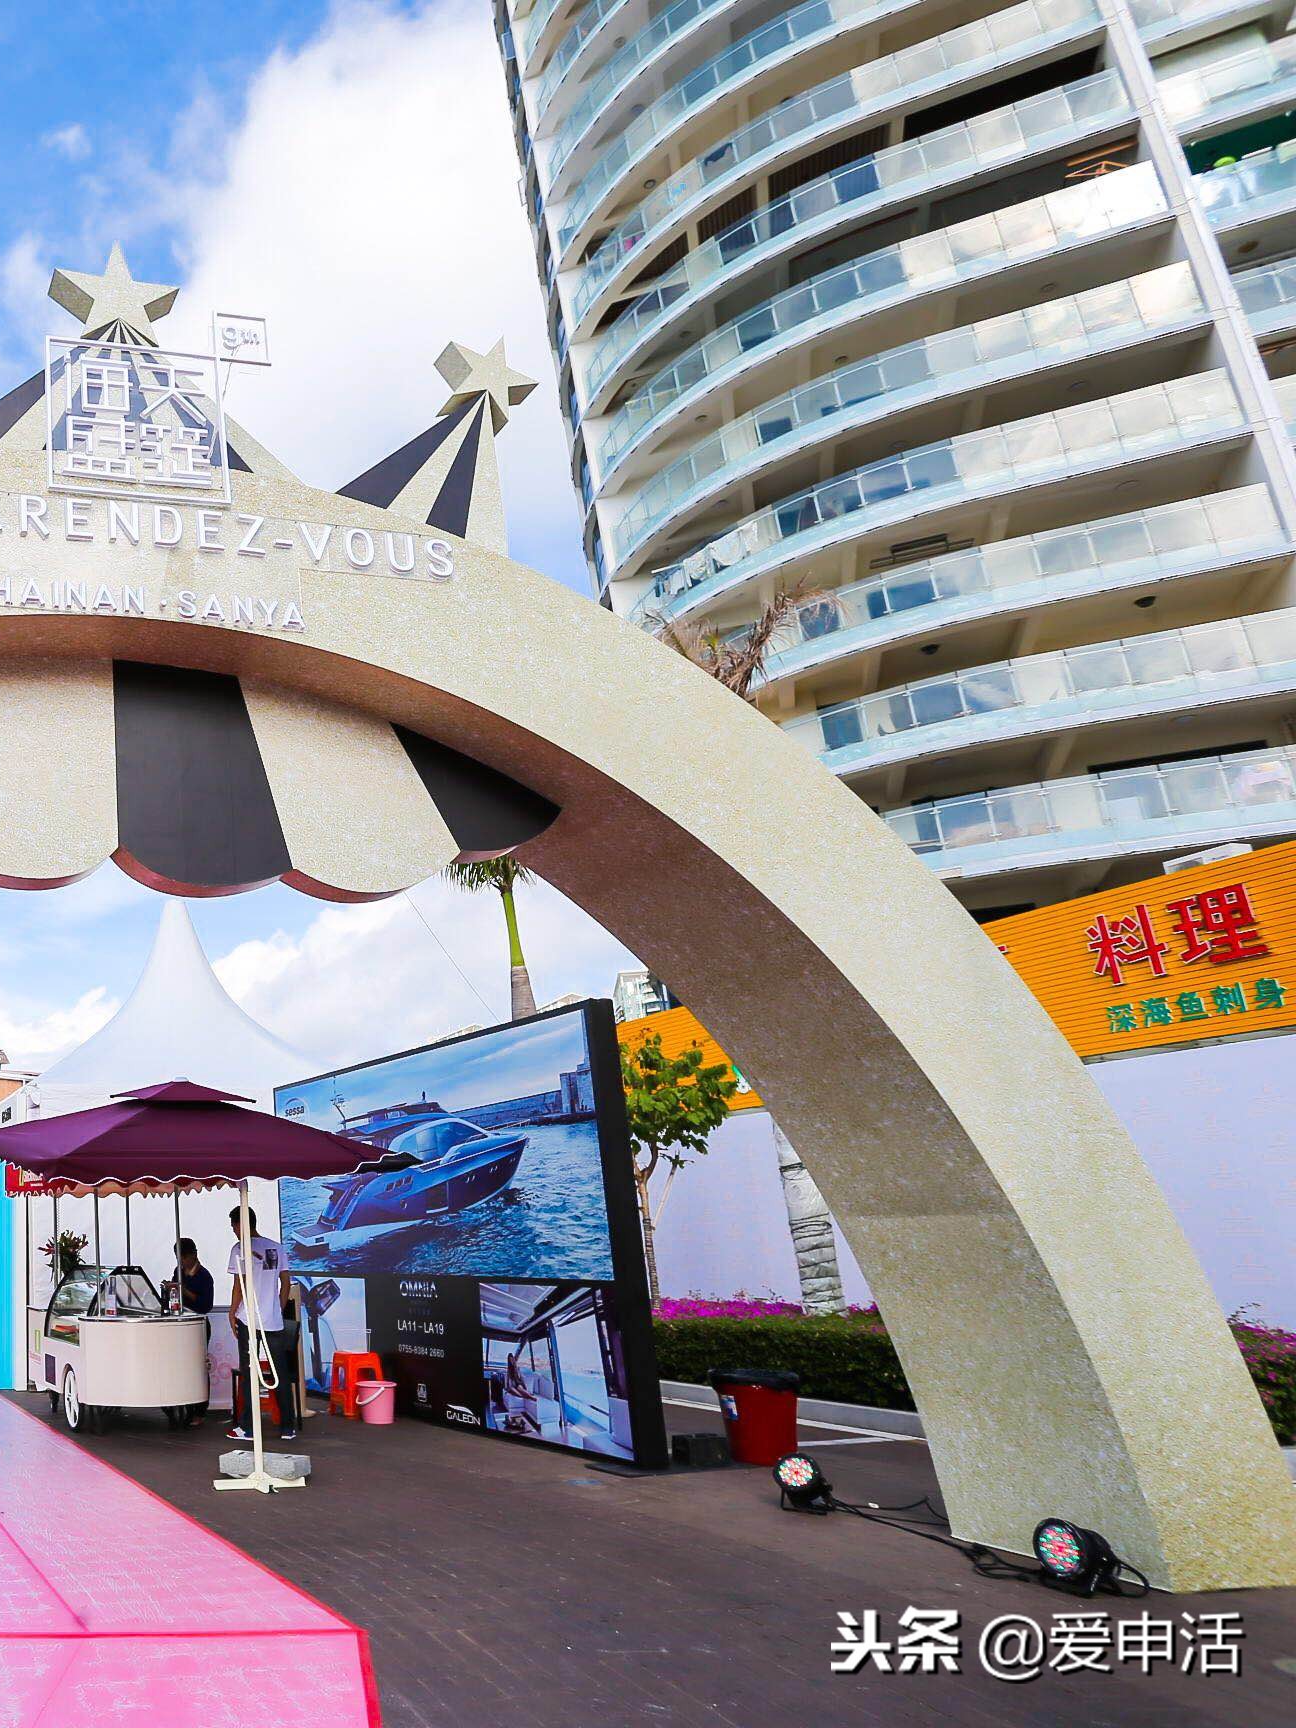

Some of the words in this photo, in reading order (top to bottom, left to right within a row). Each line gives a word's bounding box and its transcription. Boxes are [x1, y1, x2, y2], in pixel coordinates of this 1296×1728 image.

[177, 589, 306, 632] SANYA
[1084, 882, 1270, 986] 料理
[1106, 977, 1288, 1032] 深海鱼刺身
[446, 1410, 481, 1425] GALEON
